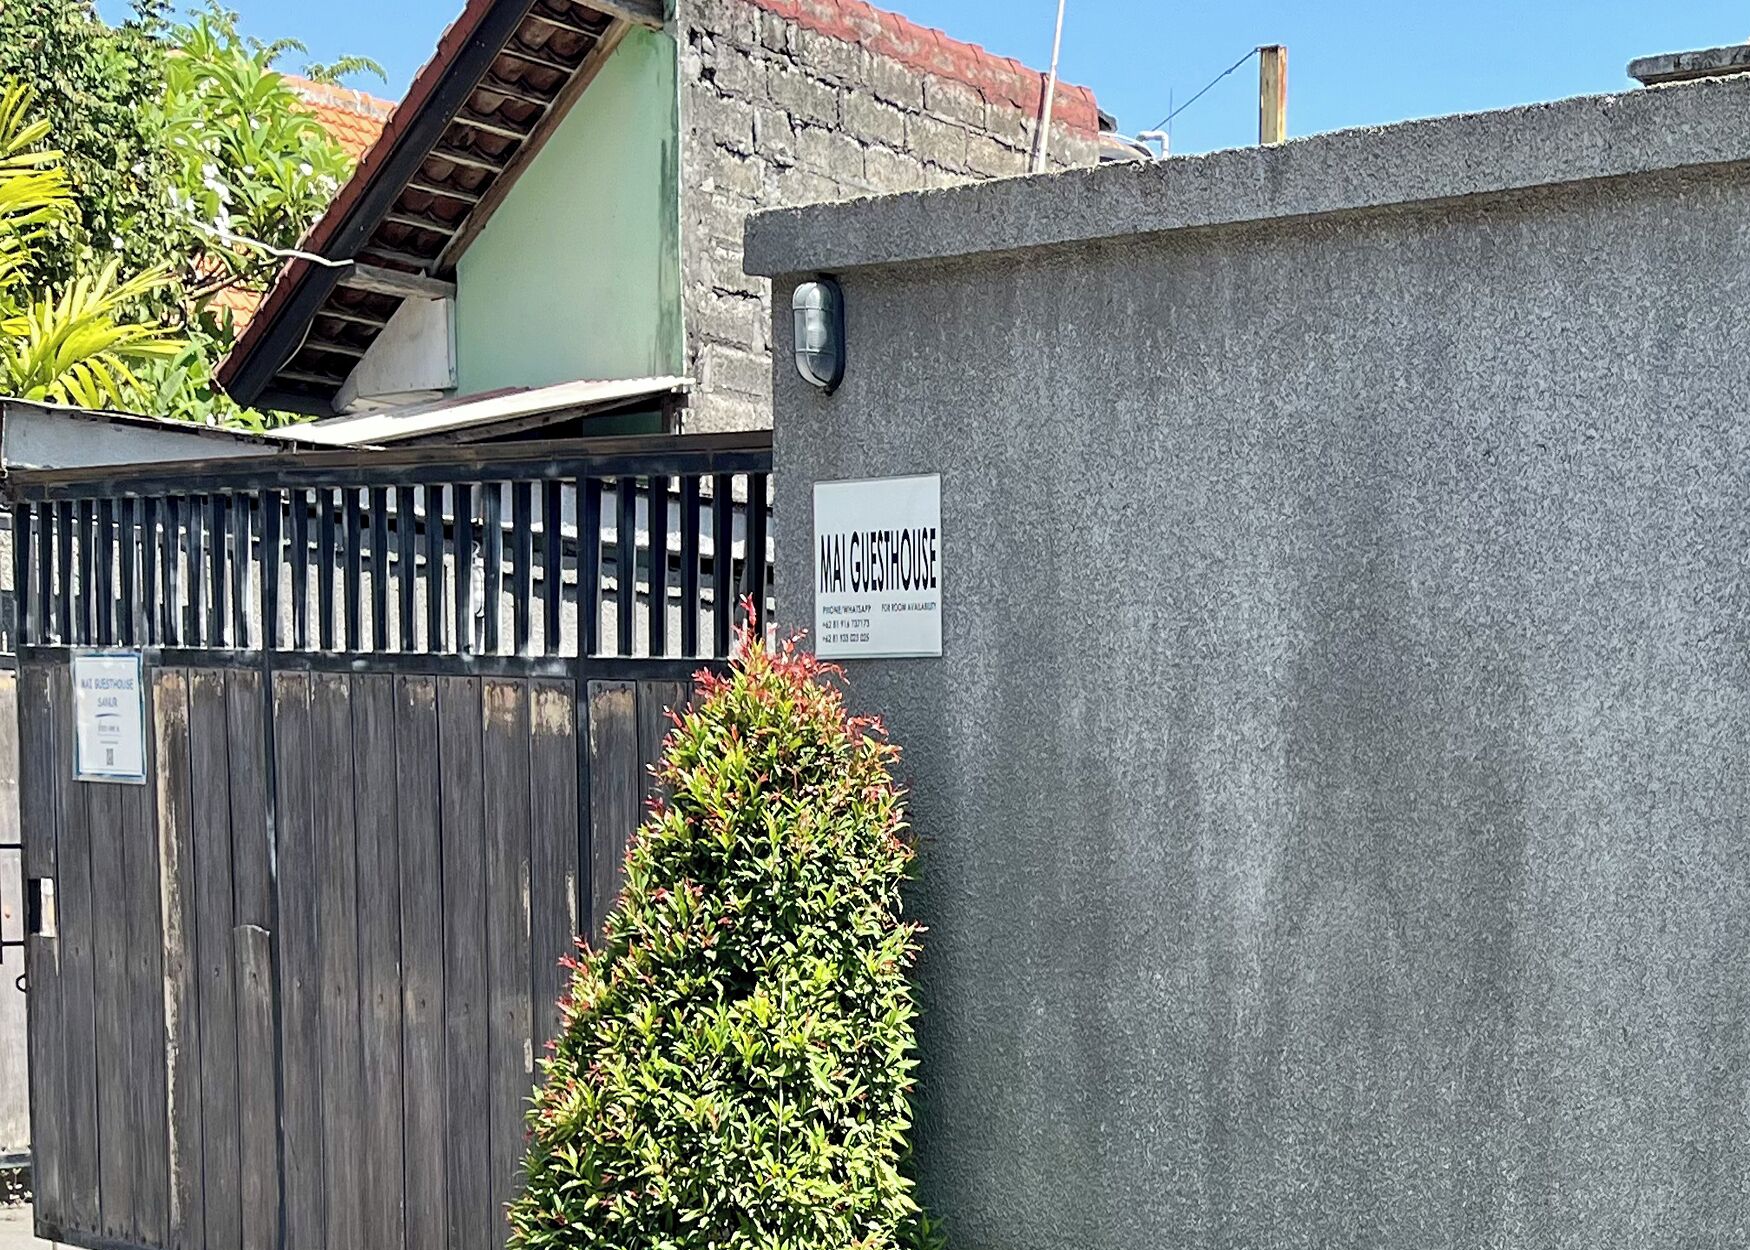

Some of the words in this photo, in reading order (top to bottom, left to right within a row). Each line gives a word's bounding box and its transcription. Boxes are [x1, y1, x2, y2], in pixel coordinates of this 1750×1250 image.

[821, 533, 846, 593] MAI
[850, 528, 937, 592] GUESTHOUSE
[881, 603, 890, 612] FOR
[891, 602, 906, 611] ROOM
[907, 601, 937, 610] AVAILABILITY
[822, 621, 832, 629] +62
[833, 620, 839, 629] 81
[822, 634, 832, 643] +62
[95, 679, 133, 690] GUESTHOUSE
